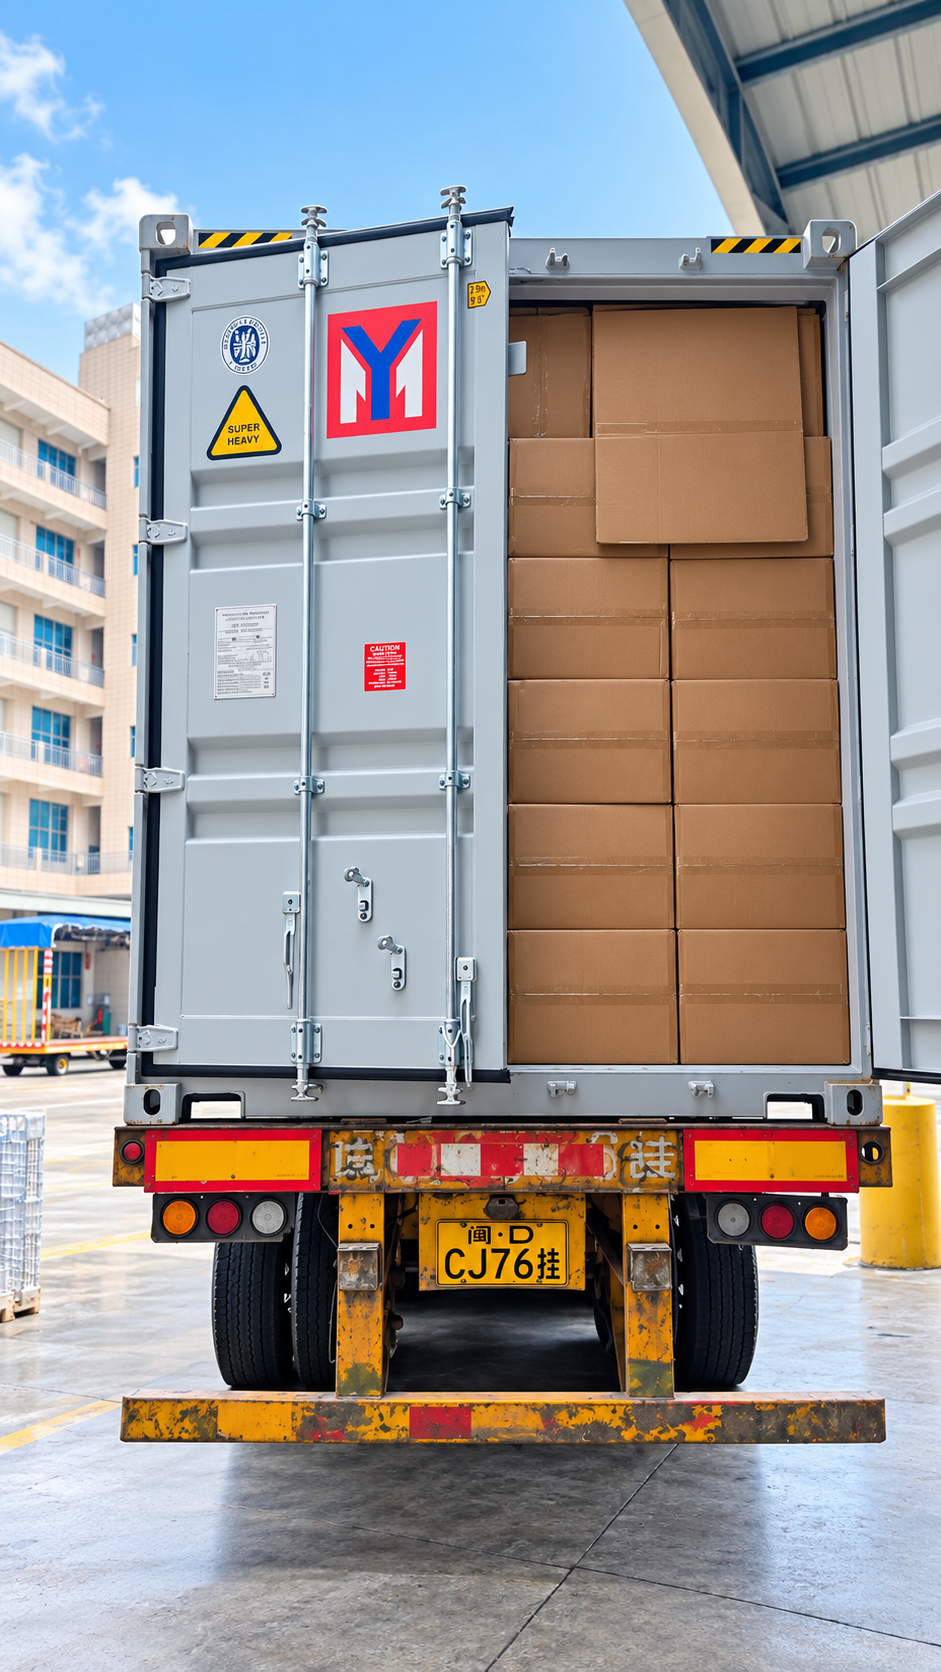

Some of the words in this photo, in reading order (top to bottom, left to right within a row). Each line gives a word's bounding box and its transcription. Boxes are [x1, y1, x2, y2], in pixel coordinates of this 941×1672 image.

[227, 422, 261, 434] SUPER
[227, 434, 260, 446] HEAVY
[369, 644, 401, 653] CAUTION
[444, 1247, 561, 1280] CJ76挂
